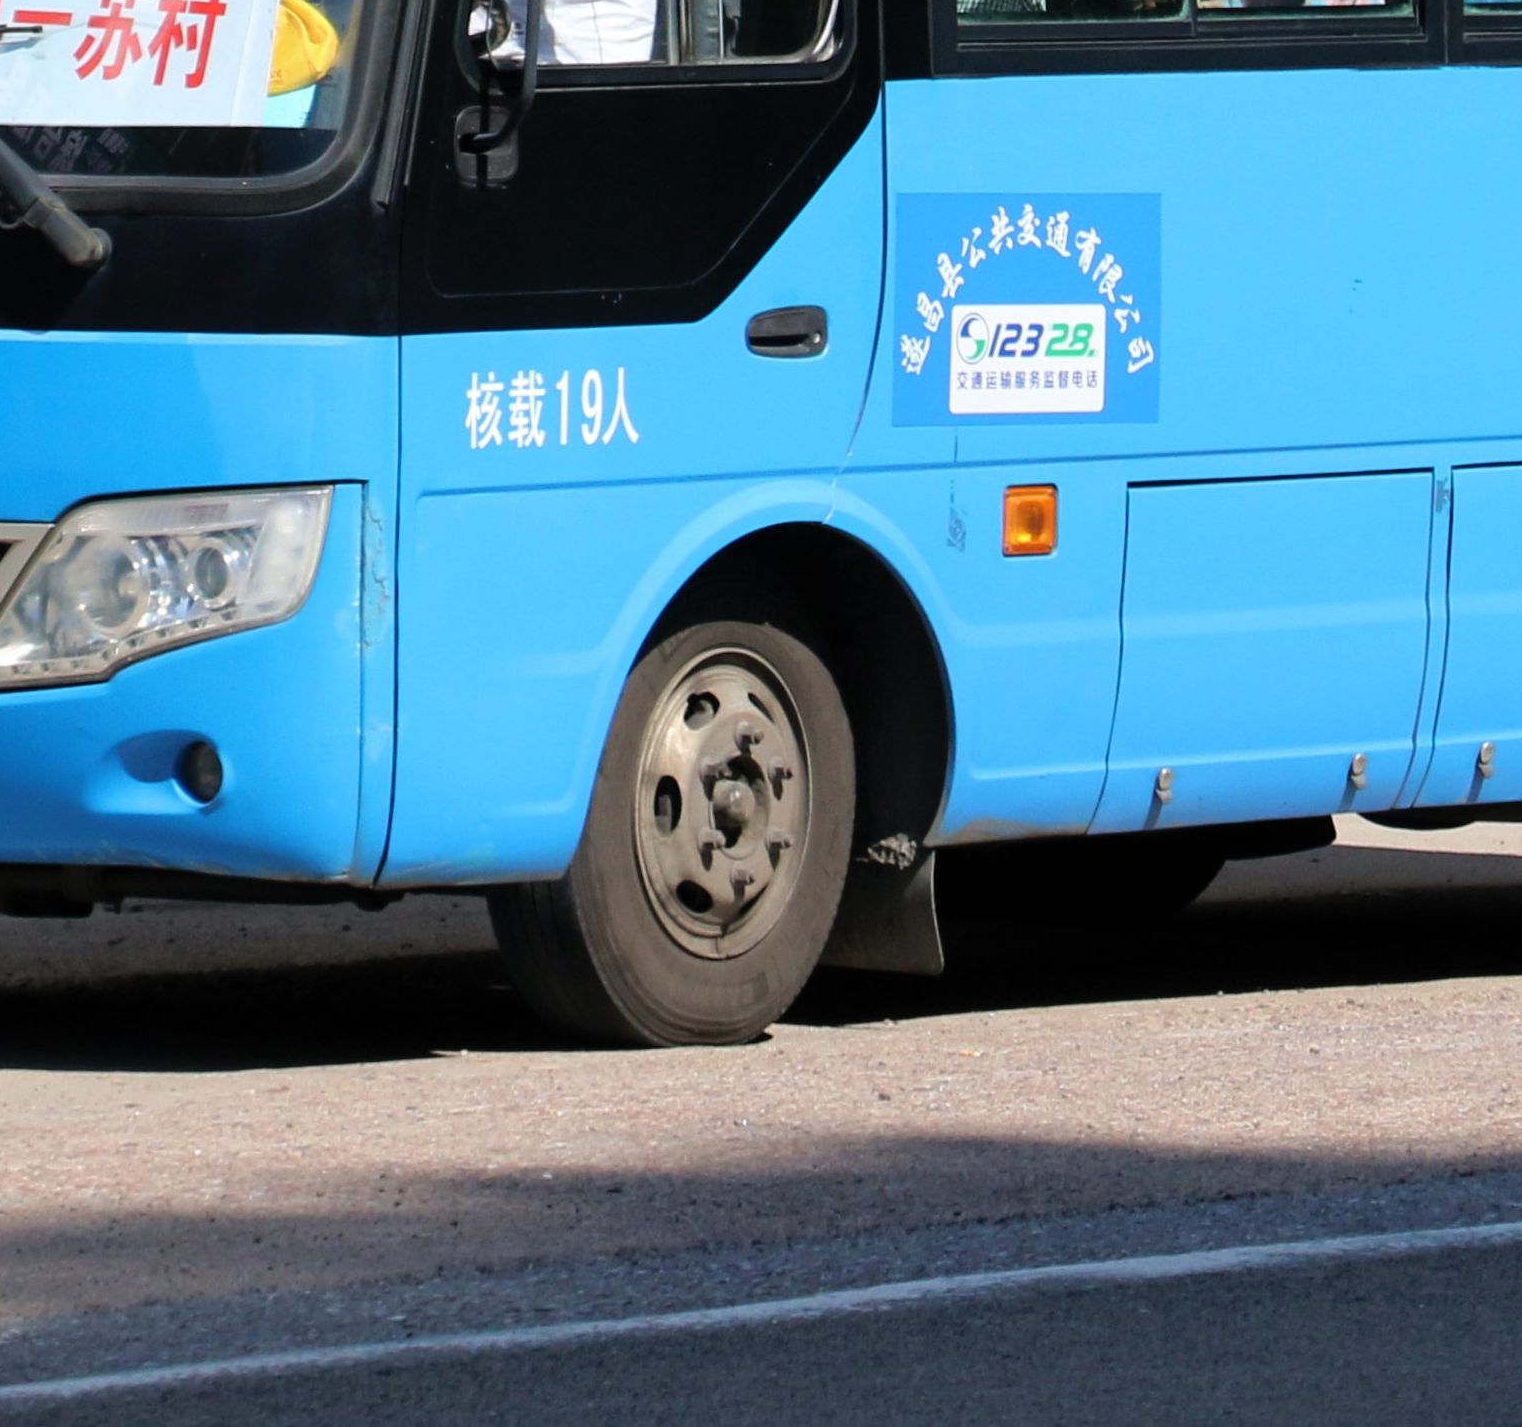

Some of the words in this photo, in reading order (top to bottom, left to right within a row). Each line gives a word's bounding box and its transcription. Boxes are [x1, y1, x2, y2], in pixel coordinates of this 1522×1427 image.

[900, 203, 1155, 375] 遂昌县公共交通有限公司
[464, 366, 641, 450] 核载19人
[956, 370, 1098, 390] 交通运输服务监督电话
